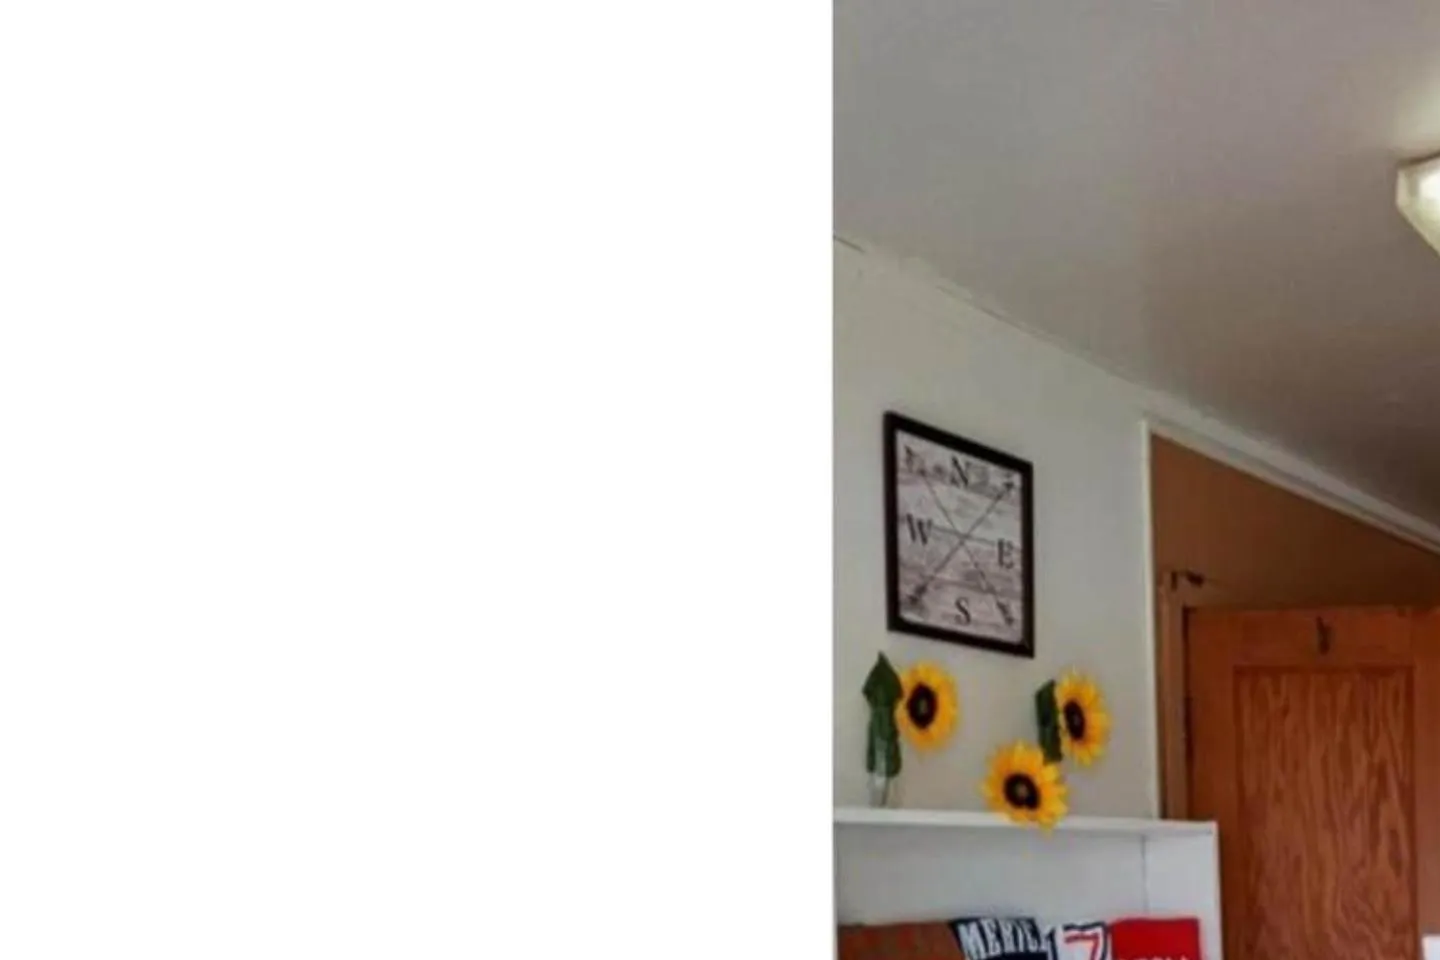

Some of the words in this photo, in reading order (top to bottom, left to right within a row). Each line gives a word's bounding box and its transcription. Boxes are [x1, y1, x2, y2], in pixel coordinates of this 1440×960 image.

[951, 456, 972, 489] N
[906, 513, 933, 546] W
[998, 538, 1014, 570] E
[954, 597, 971, 625] S
